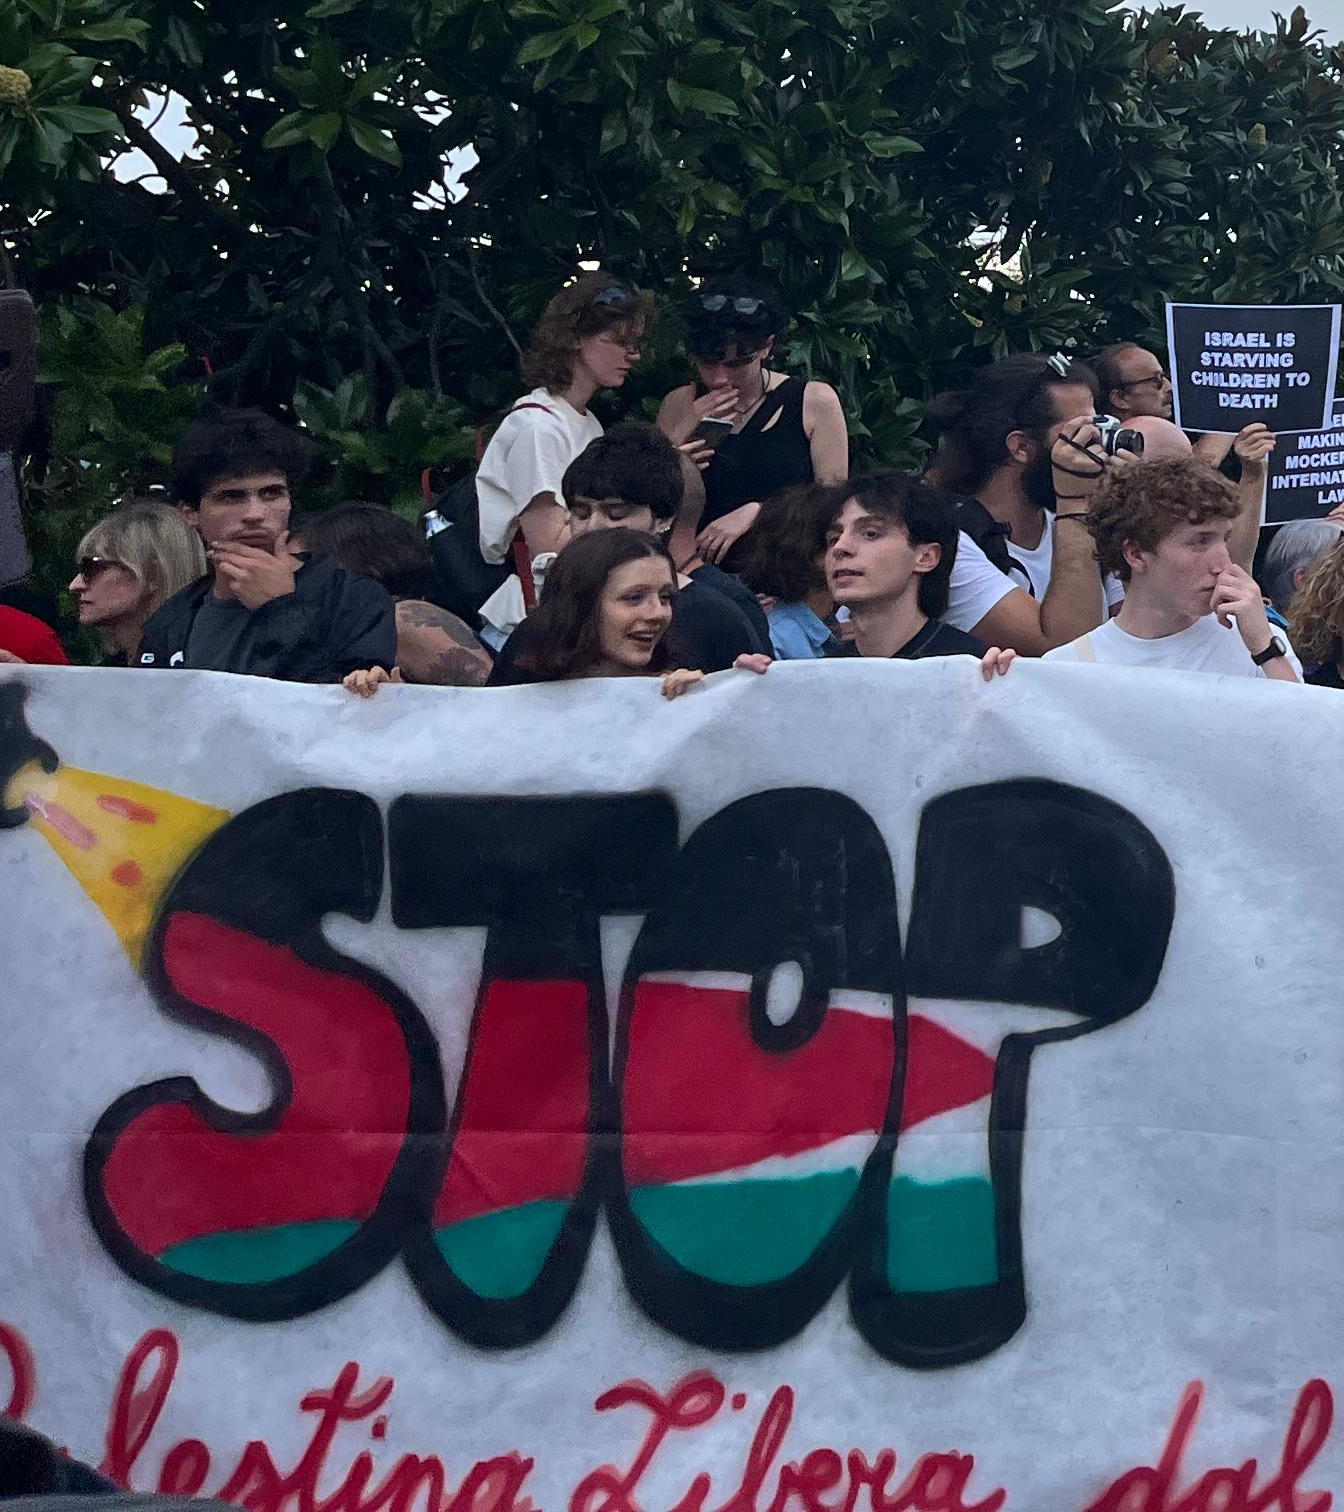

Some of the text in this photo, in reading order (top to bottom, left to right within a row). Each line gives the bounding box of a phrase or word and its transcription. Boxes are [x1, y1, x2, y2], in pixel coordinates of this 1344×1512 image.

[1204, 331, 1296, 348] ISRAEL IS
[1200, 352, 1294, 368] STARVING
[1190, 371, 1311, 388] CHILDREN TO
[1218, 393, 1278, 408] DEATH
[83, 776, 1178, 1370] STOP
